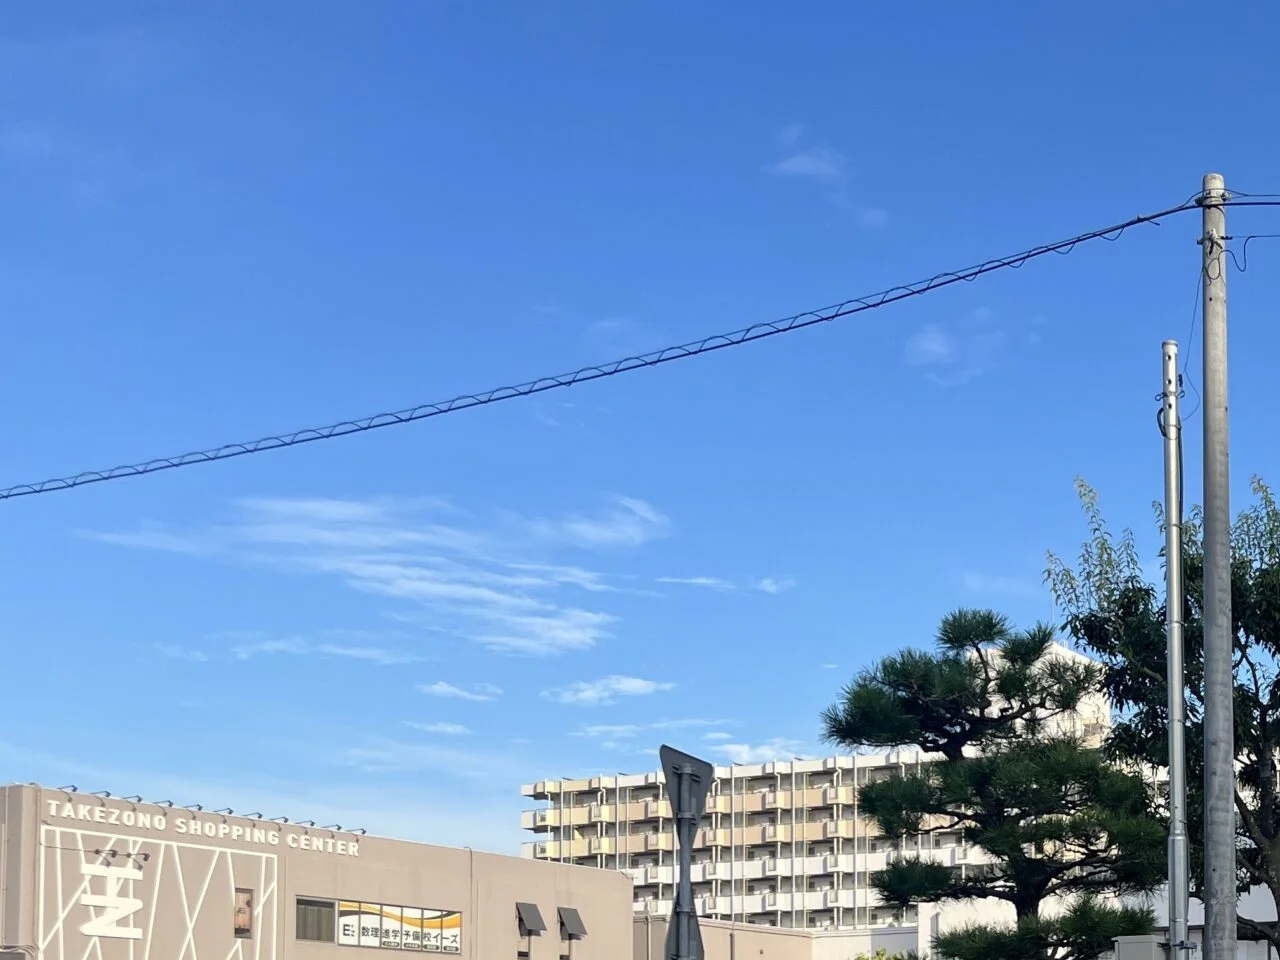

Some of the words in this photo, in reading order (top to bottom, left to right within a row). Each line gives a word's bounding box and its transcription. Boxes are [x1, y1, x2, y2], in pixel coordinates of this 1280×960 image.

[47, 799, 167, 831] TAKEZONO
[175, 817, 280, 846] SHOPPING
[286, 833, 360, 857] CENTER
